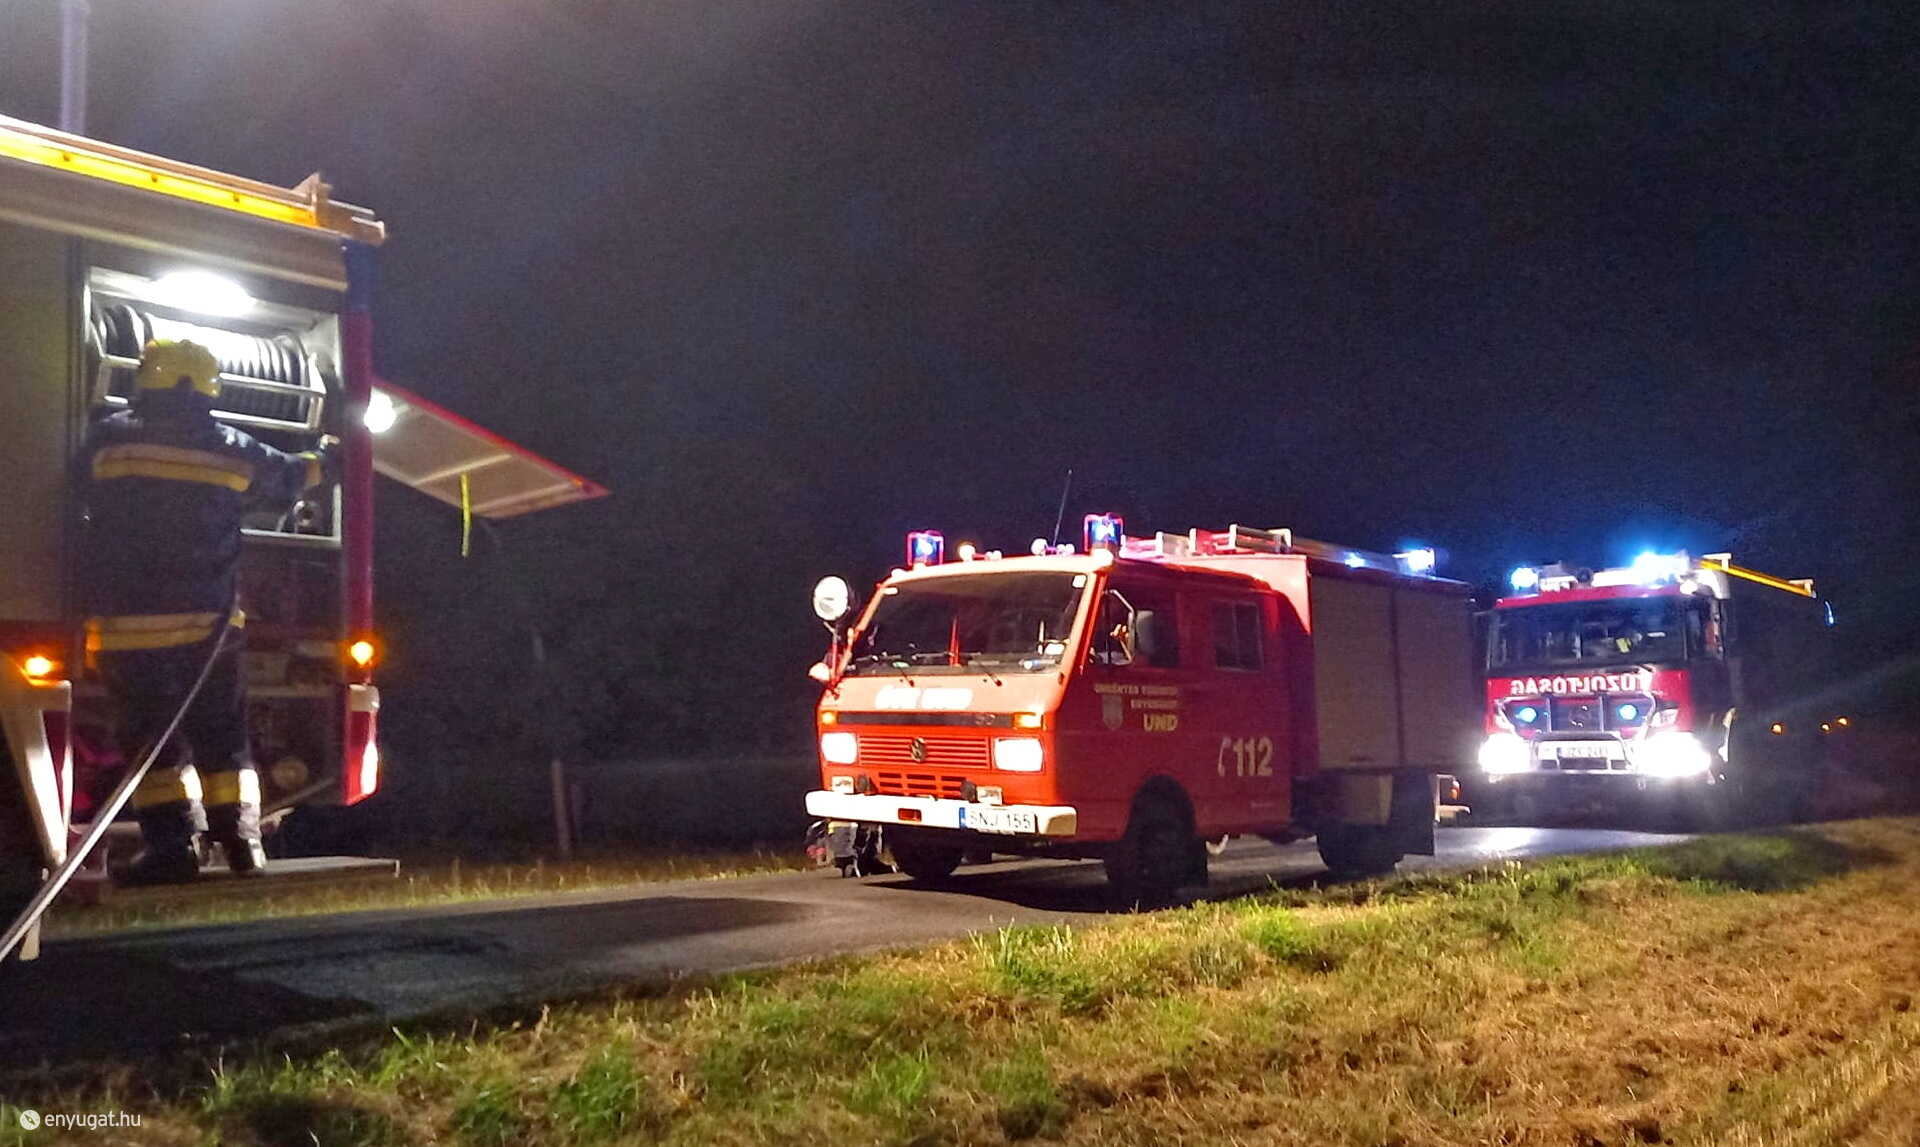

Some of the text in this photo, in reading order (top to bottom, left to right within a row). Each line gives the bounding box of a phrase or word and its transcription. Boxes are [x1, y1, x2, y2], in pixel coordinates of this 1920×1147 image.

[1143, 713, 1178, 732] UND
[1233, 736, 1273, 776] 112
[1006, 813, 1031, 829] 155
